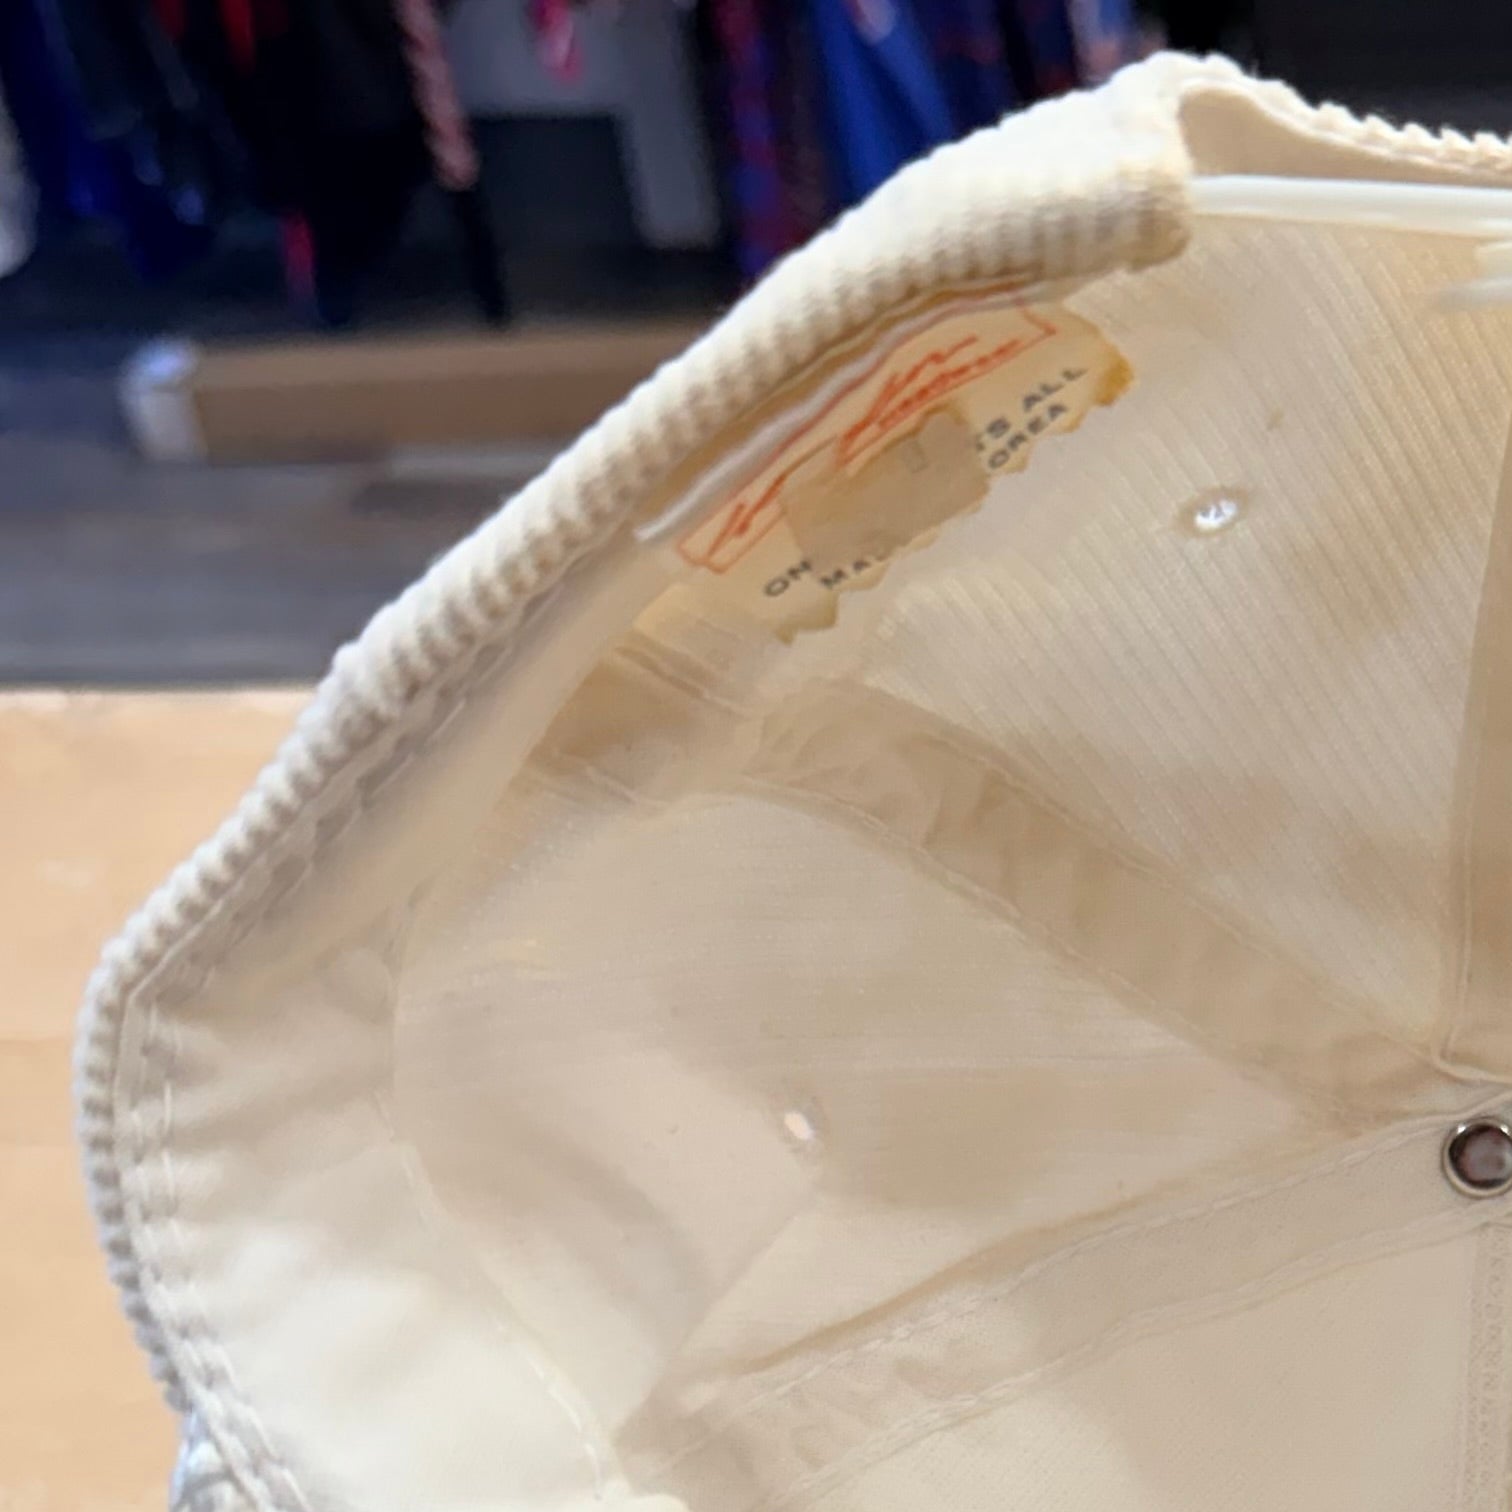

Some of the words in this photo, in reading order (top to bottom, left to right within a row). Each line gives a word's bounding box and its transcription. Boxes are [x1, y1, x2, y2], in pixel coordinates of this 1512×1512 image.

[764, 560, 812, 597] ON
[1022, 366, 1089, 413] ALL
[988, 403, 1069, 470] OREA
